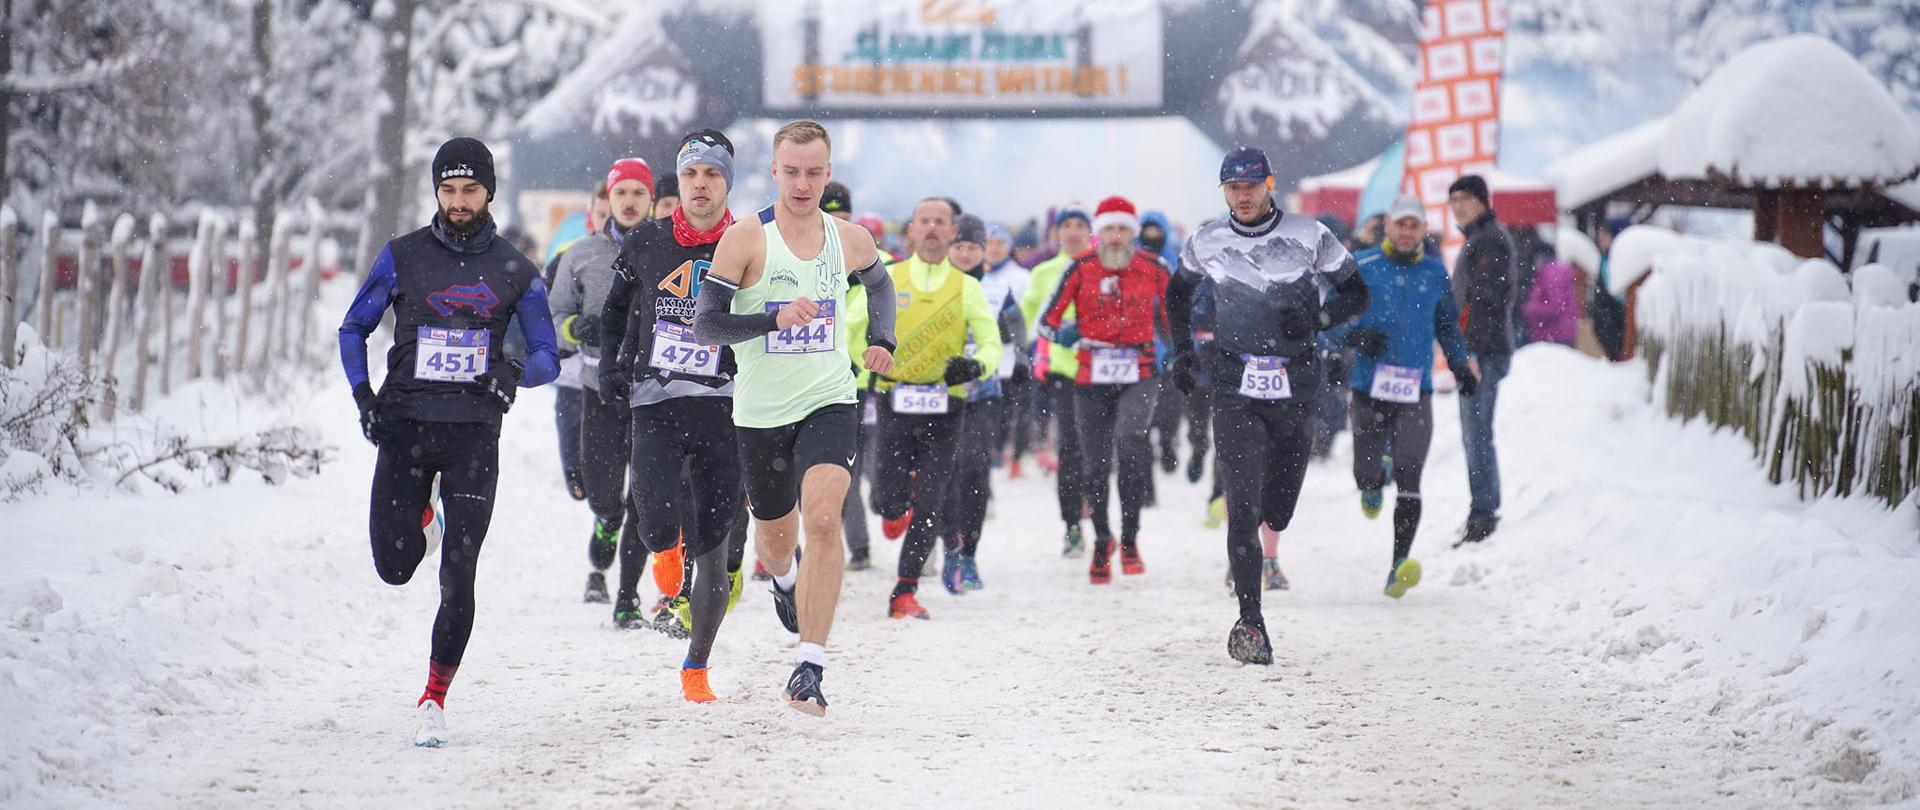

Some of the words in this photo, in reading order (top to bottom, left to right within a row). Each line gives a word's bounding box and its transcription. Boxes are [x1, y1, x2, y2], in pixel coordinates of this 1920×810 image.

[777, 324, 827, 344] 444
[427, 352, 476, 373] 451
[661, 345, 710, 368] 479
[1099, 363, 1131, 377] 477
[1247, 374, 1283, 391] 530
[1380, 381, 1412, 396] 466
[903, 396, 940, 409] 546
